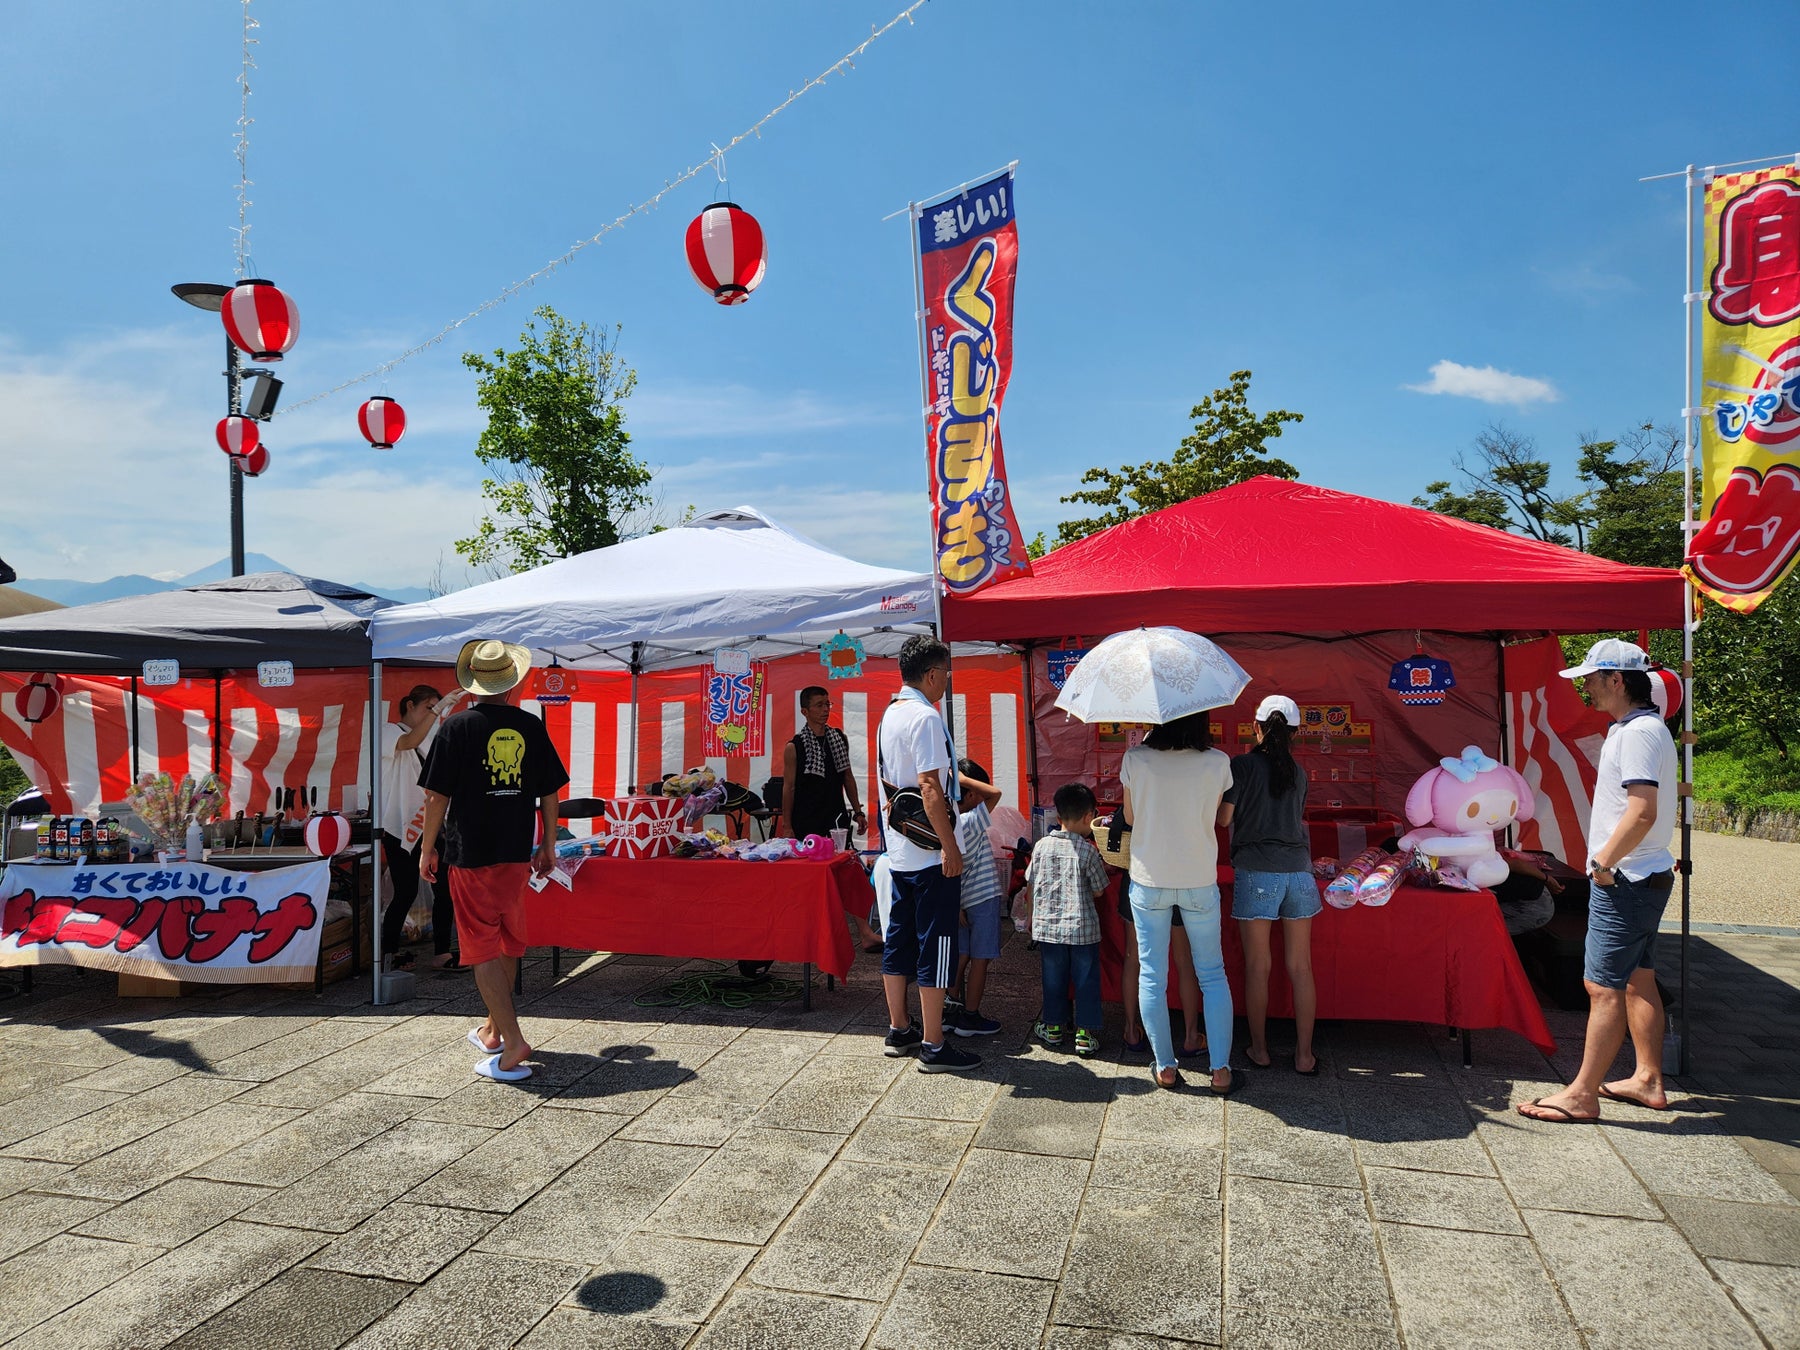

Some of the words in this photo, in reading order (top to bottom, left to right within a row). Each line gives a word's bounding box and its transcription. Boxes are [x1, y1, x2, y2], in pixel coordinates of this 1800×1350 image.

[932, 186, 1008, 244] 楽しい!
[931, 325, 952, 417] ドキドキ
[939, 240, 996, 589] くじ引き
[984, 479, 1012, 566] わくわく
[152, 674, 172, 682] ¥300
[269, 676, 288, 684] ¥300
[652, 819, 674, 830] LUCKY
[71, 870, 248, 896] 甘くておいしい
